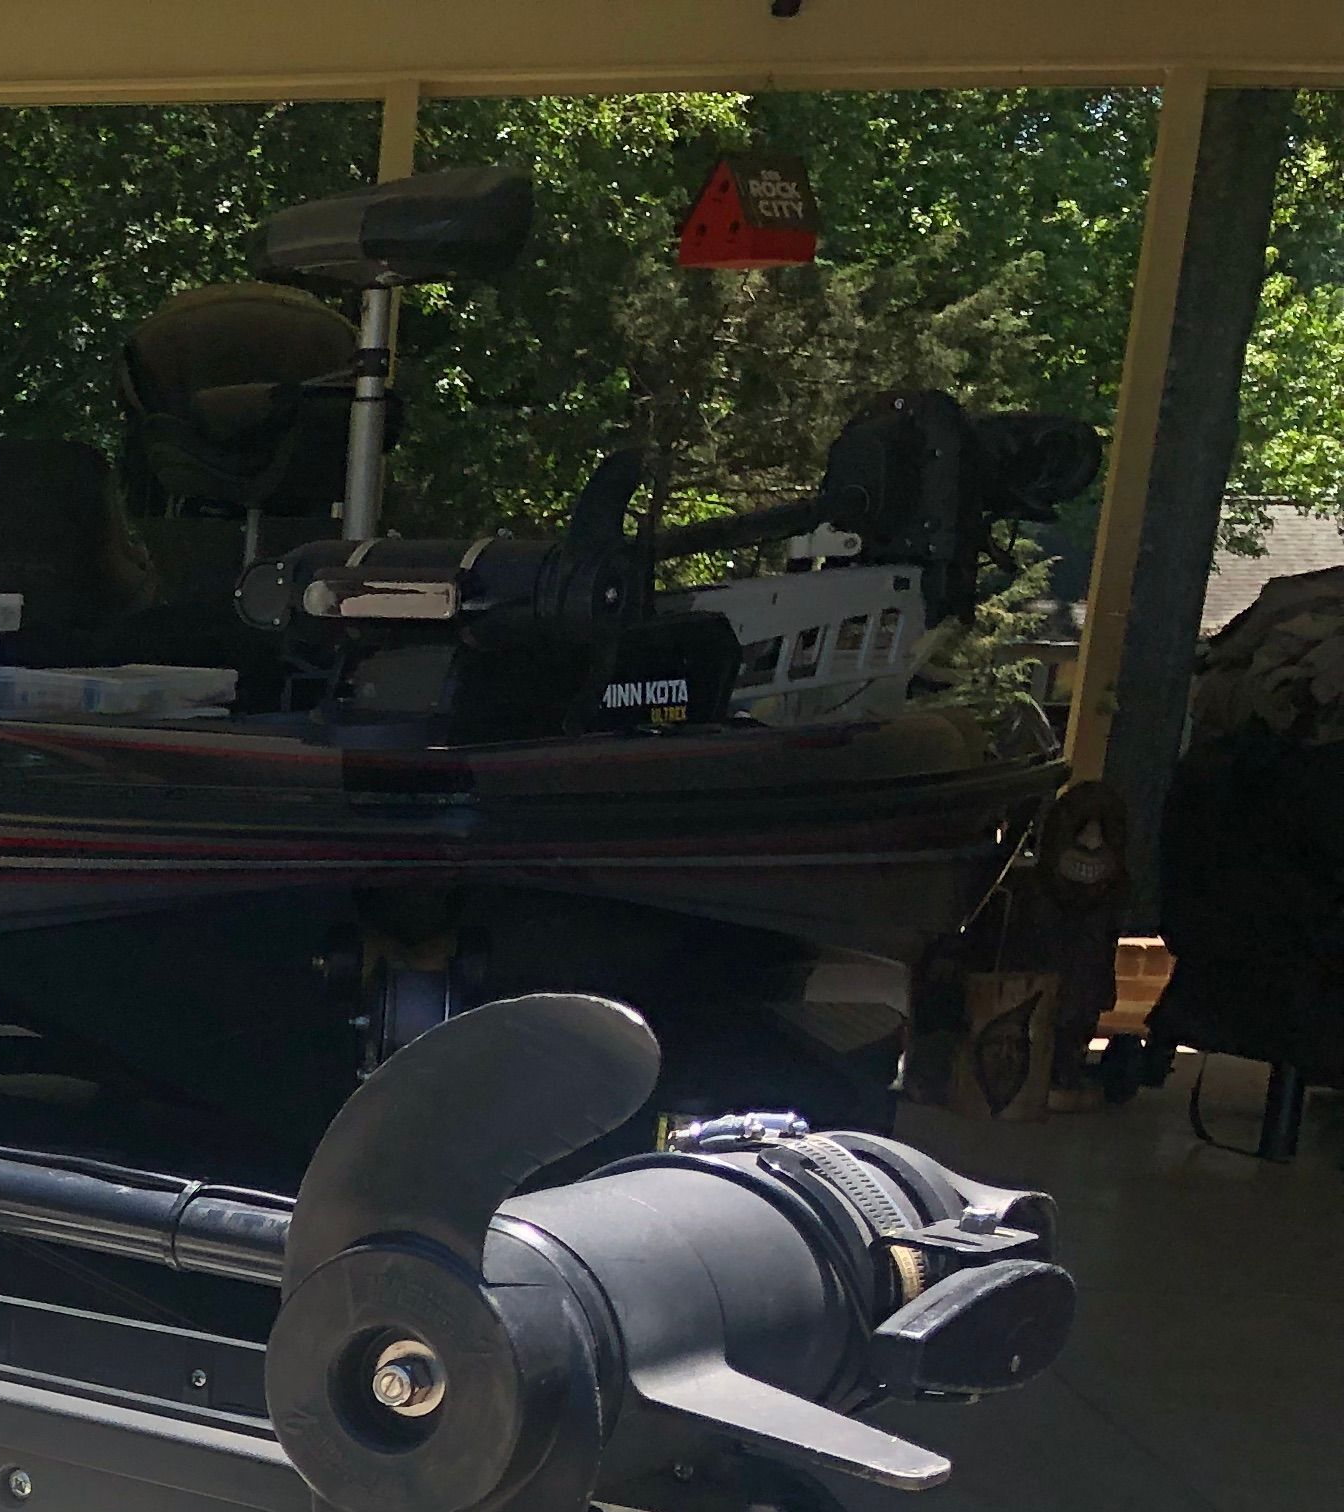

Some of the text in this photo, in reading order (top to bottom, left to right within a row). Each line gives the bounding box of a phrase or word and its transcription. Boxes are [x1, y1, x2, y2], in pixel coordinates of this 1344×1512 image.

[748, 180, 801, 199] ROCK
[758, 200, 804, 218] CITY
[645, 679, 688, 704] KOTA
